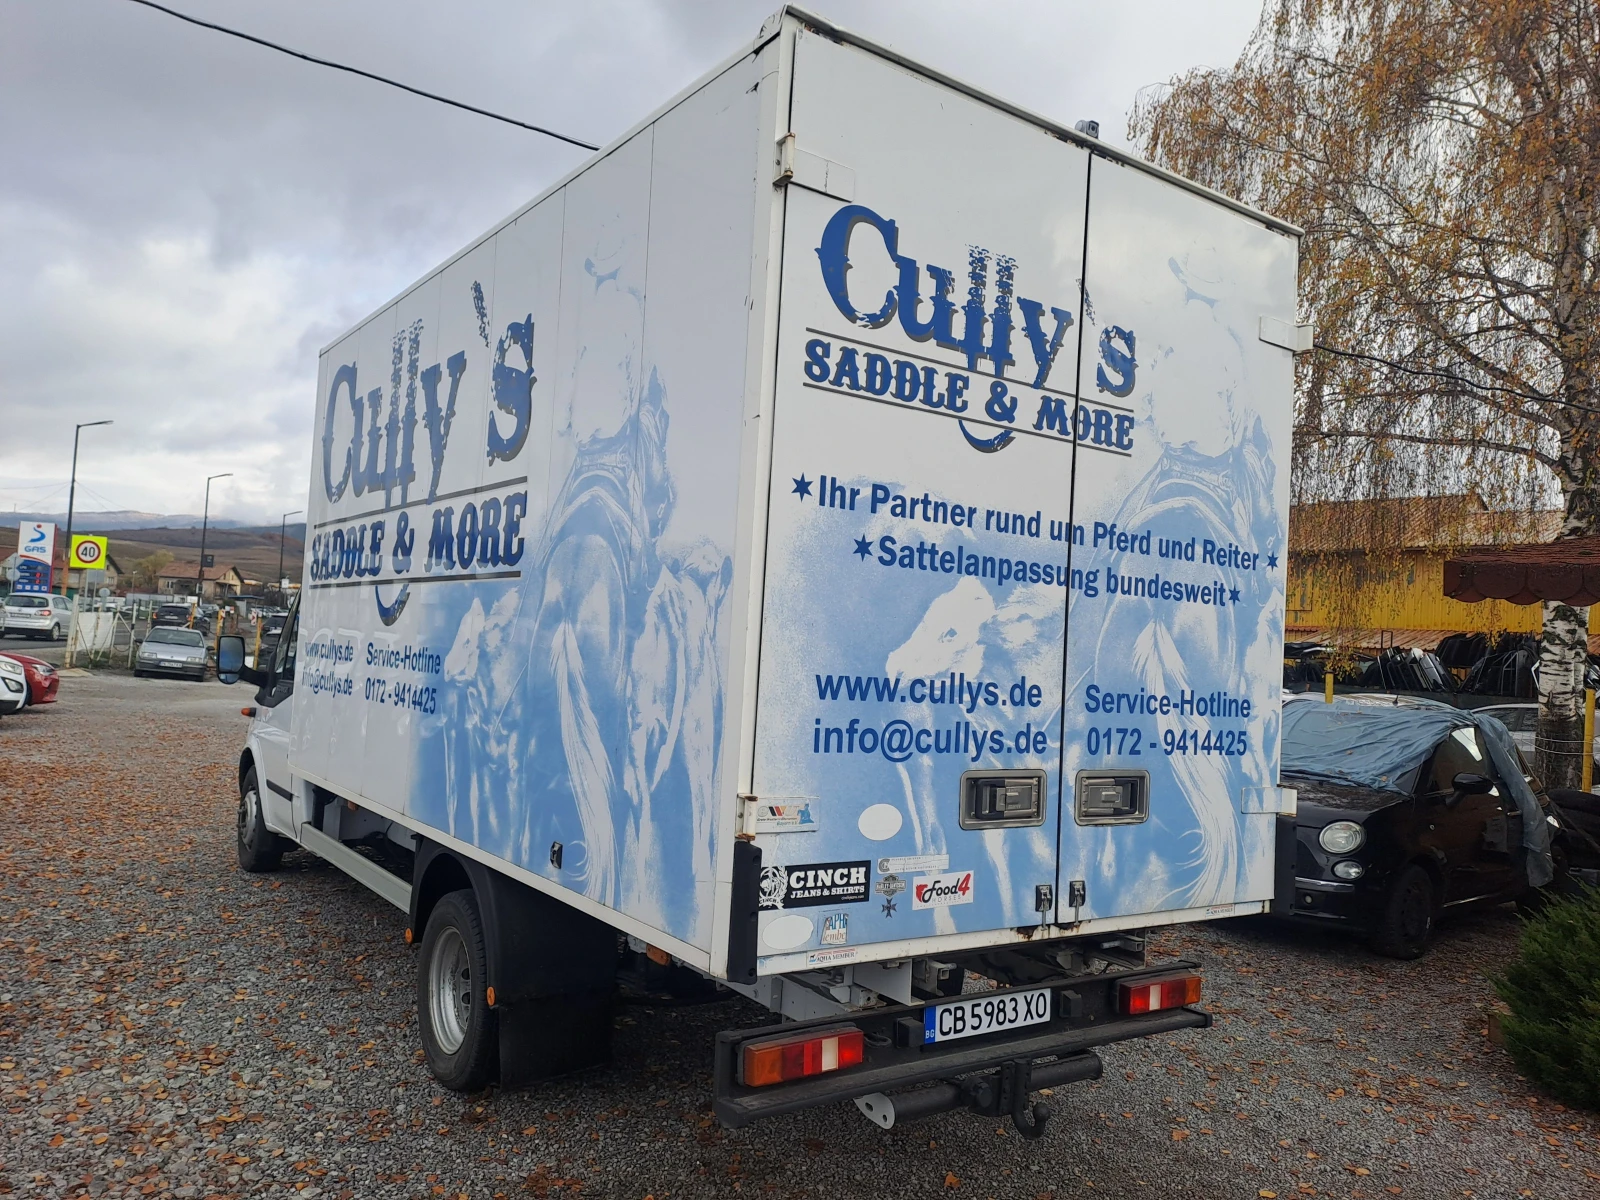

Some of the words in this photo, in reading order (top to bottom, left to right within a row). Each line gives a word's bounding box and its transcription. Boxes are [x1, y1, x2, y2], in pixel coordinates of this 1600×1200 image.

[804, 339, 970, 414] SADDLE
[985, 380, 1019, 424] &
[1032, 395, 1135, 451] MORE
[310, 519, 385, 581] SADDLE
[392, 511, 415, 574] &
[423, 490, 528, 574] MORE
[818, 474, 861, 511] Ihr
[870, 483, 977, 528] Partner
[985, 509, 1042, 539] rund
[1049, 520, 1084, 545] um
[1093, 520, 1152, 557] Pferd
[1158, 533, 1196, 562] und
[1202, 538, 1260, 571] Reiter
[24, 545, 47, 554] GAS
[80, 546, 96, 558] 40
[878, 535, 1099, 597] Sattelanpassung
[1106, 567, 1227, 606] bundesweit
[366, 642, 441, 675] Service-Hotline
[365, 677, 386, 703] 0172
[394, 684, 437, 714] 9414425
[816, 673, 1043, 714] www.cullys.de
[1084, 685, 1252, 718] Service-Hotline
[813, 719, 1048, 763] info@cullys.de
[1087, 727, 1142, 756] 0172
[1163, 729, 1248, 757] 9414425
[789, 867, 867, 889] CINCH
[790, 888, 822, 899] JEANS
[822, 888, 830, 896] &
[831, 885, 865, 895] SHIRTS
[939, 1005, 966, 1036] CB
[970, 997, 1018, 1031] 5983
[1023, 992, 1047, 1022] XO
[925, 1029, 935, 1039] BG
